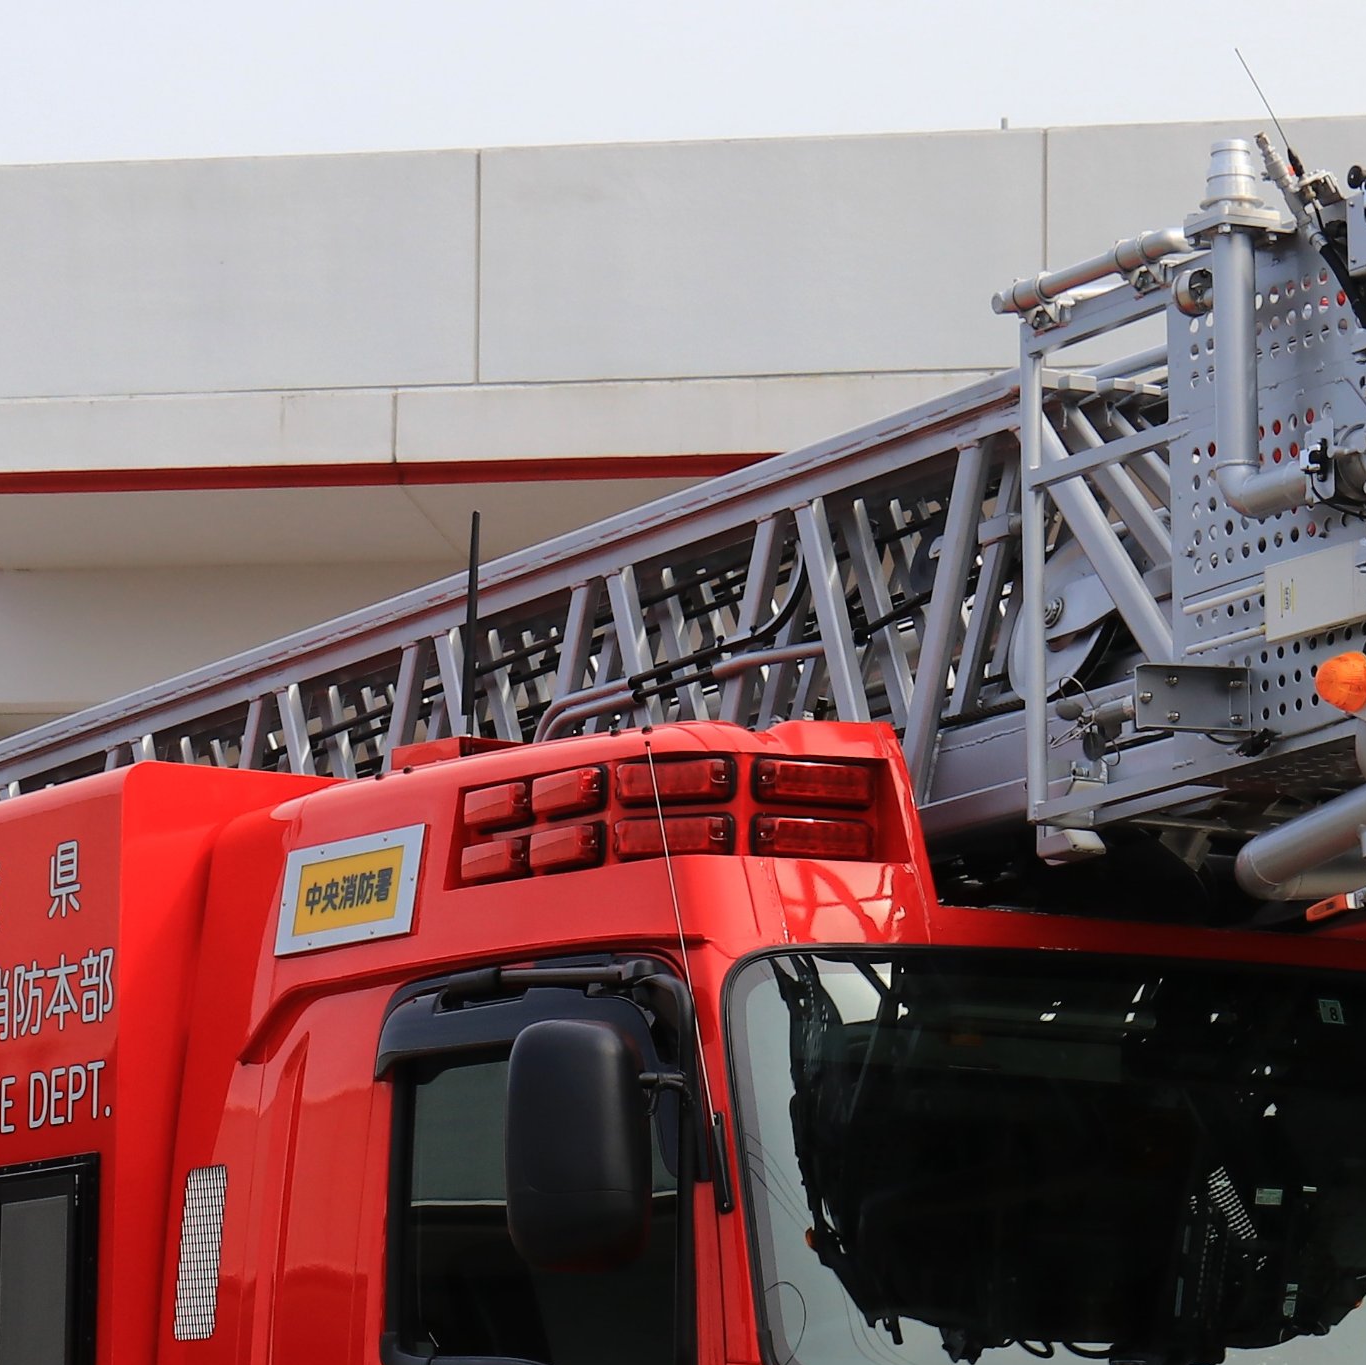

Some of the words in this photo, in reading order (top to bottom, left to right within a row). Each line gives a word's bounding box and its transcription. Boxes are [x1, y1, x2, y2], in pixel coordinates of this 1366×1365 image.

[304, 866, 394, 916] 中央消防署
[27, 1060, 113, 1131] DEPT.
